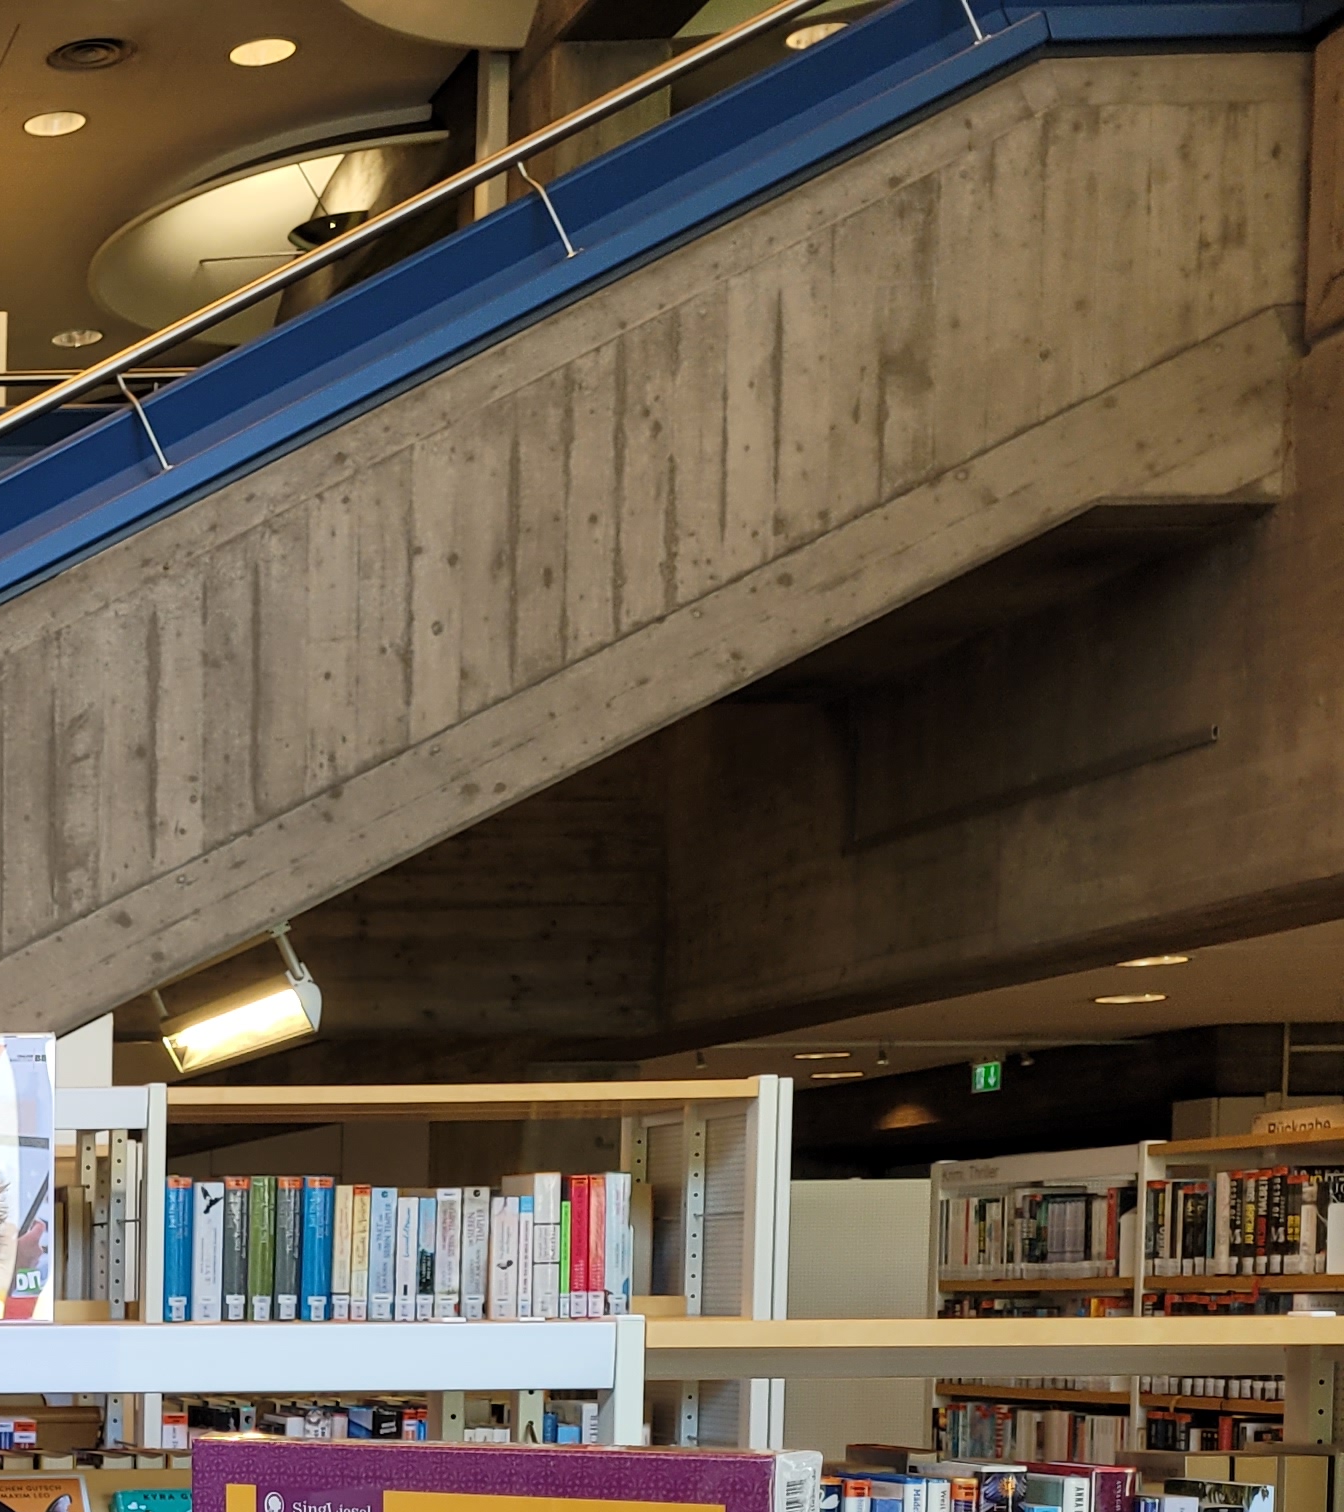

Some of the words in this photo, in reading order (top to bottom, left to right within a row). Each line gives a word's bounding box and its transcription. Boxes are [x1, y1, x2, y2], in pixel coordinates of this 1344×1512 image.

[26, 1483, 62, 1492] GUTSCH
[0, 1491, 30, 1499] MAXIM
[33, 1491, 52, 1499] LEO
